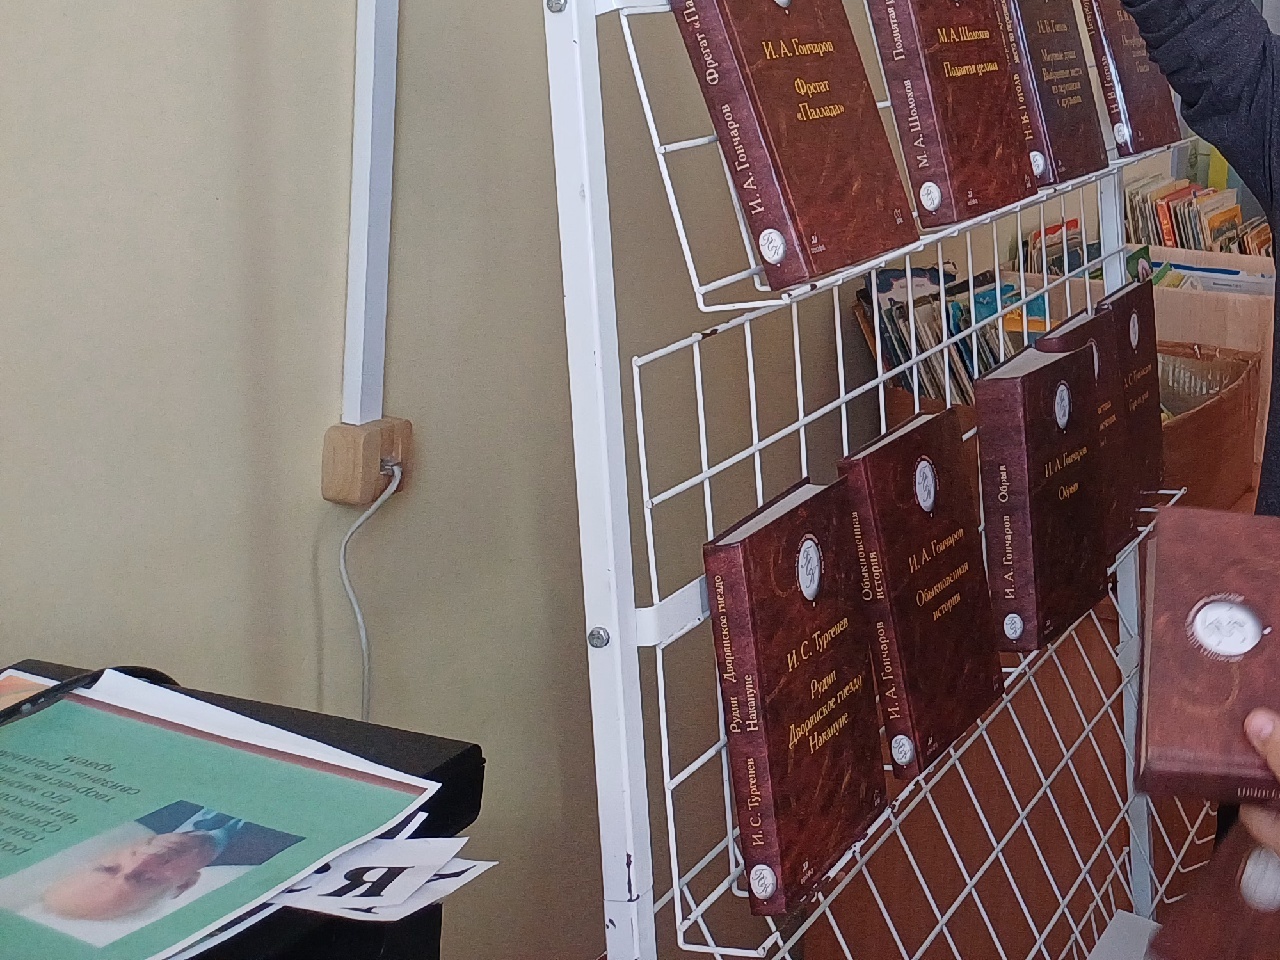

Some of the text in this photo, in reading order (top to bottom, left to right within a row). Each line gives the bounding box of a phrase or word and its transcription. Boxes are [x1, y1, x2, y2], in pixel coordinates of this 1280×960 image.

[697, 31, 720, 86] Фрегат
[762, 38, 834, 60] И. А. Гончаров
[887, 7, 906, 61] Поднятая
[794, 77, 830, 99] Фрегат
[903, 79, 922, 133] Шолохов
[721, 103, 765, 216] И. А. Гончаров
[913, 133, 926, 148] А.
[916, 150, 930, 169] М.
[851, 511, 873, 602] Обыкновенная
[908, 527, 965, 574] И. А. Гончаров
[998, 464, 1015, 599] И. А. Гончаров Обрыв
[869, 551, 885, 600] история
[933, 592, 961, 622] история
[714, 575, 742, 733] Рудин Дворянское гнездо
[787, 617, 849, 673] И. С. Тургенев
[876, 620, 901, 720] И. А. Гончаров
[744, 674, 759, 732] Накануне
[810, 669, 837, 700] Рудин
[788, 674, 862, 750] Дворянское гнездо
[808, 712, 849, 754] Накануне
[747, 757, 764, 846] И. С. Тургенев
